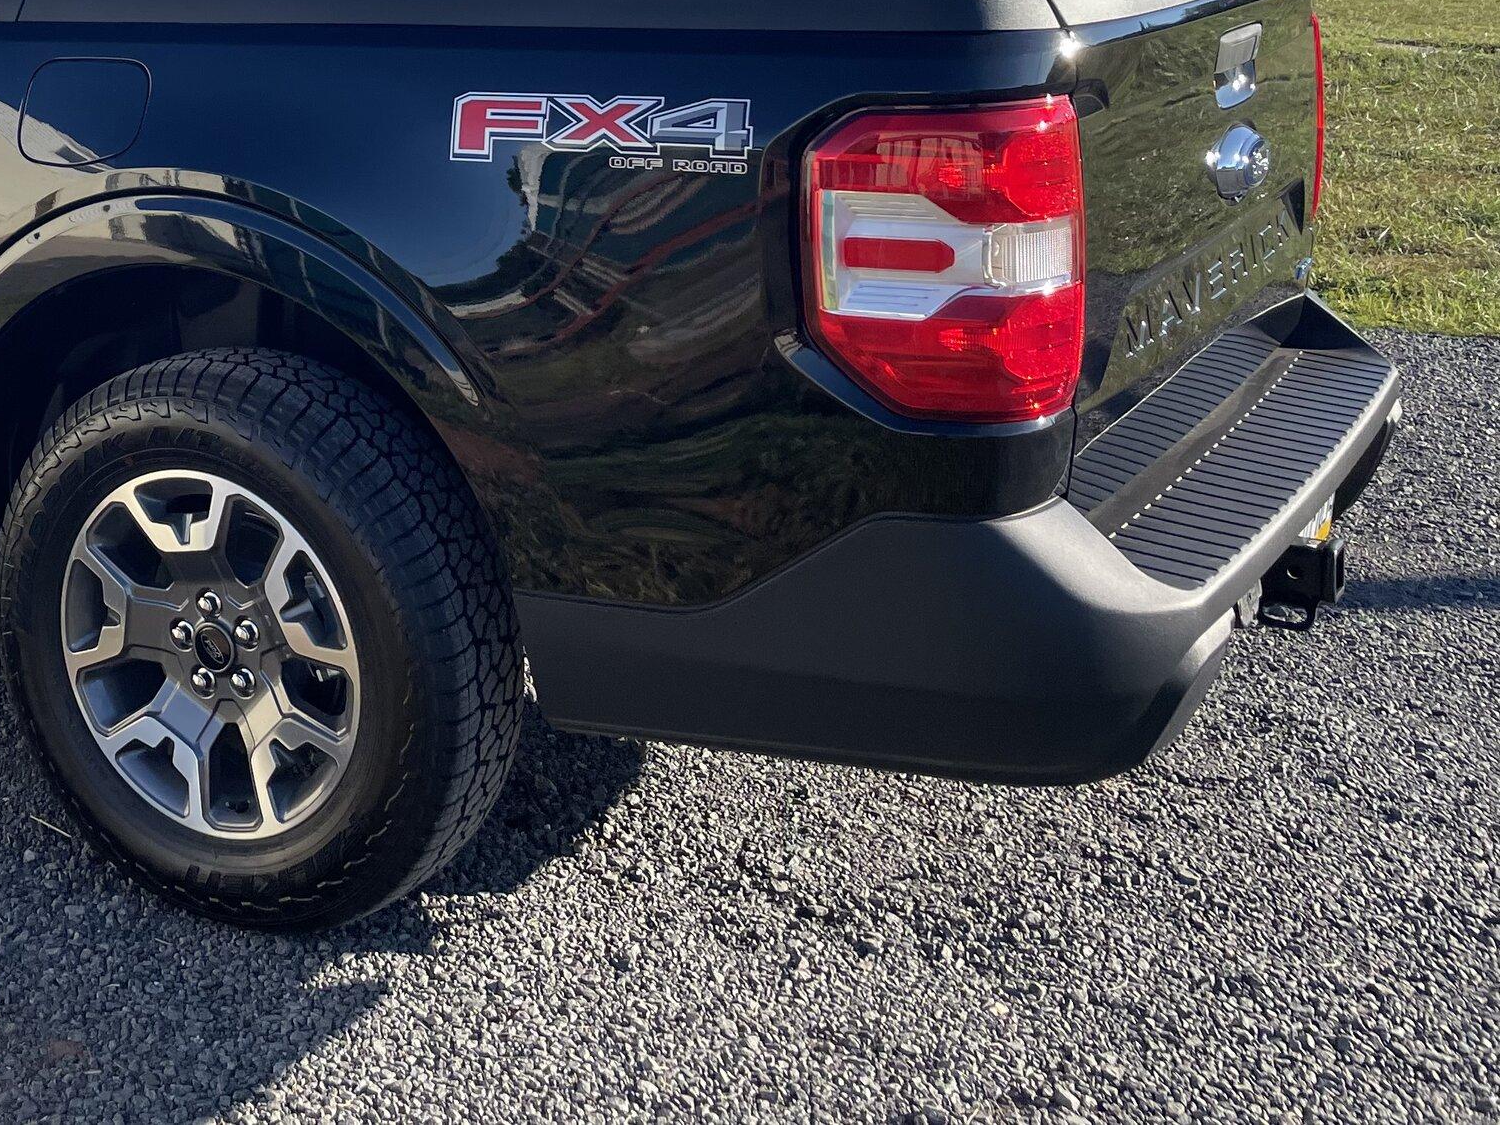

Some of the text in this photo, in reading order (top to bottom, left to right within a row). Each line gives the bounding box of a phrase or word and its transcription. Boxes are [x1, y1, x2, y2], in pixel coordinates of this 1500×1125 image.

[450, 91, 753, 163] FX4
[609, 156, 748, 174] OFF ROAD
[1125, 209, 1290, 358] MAVERICK
